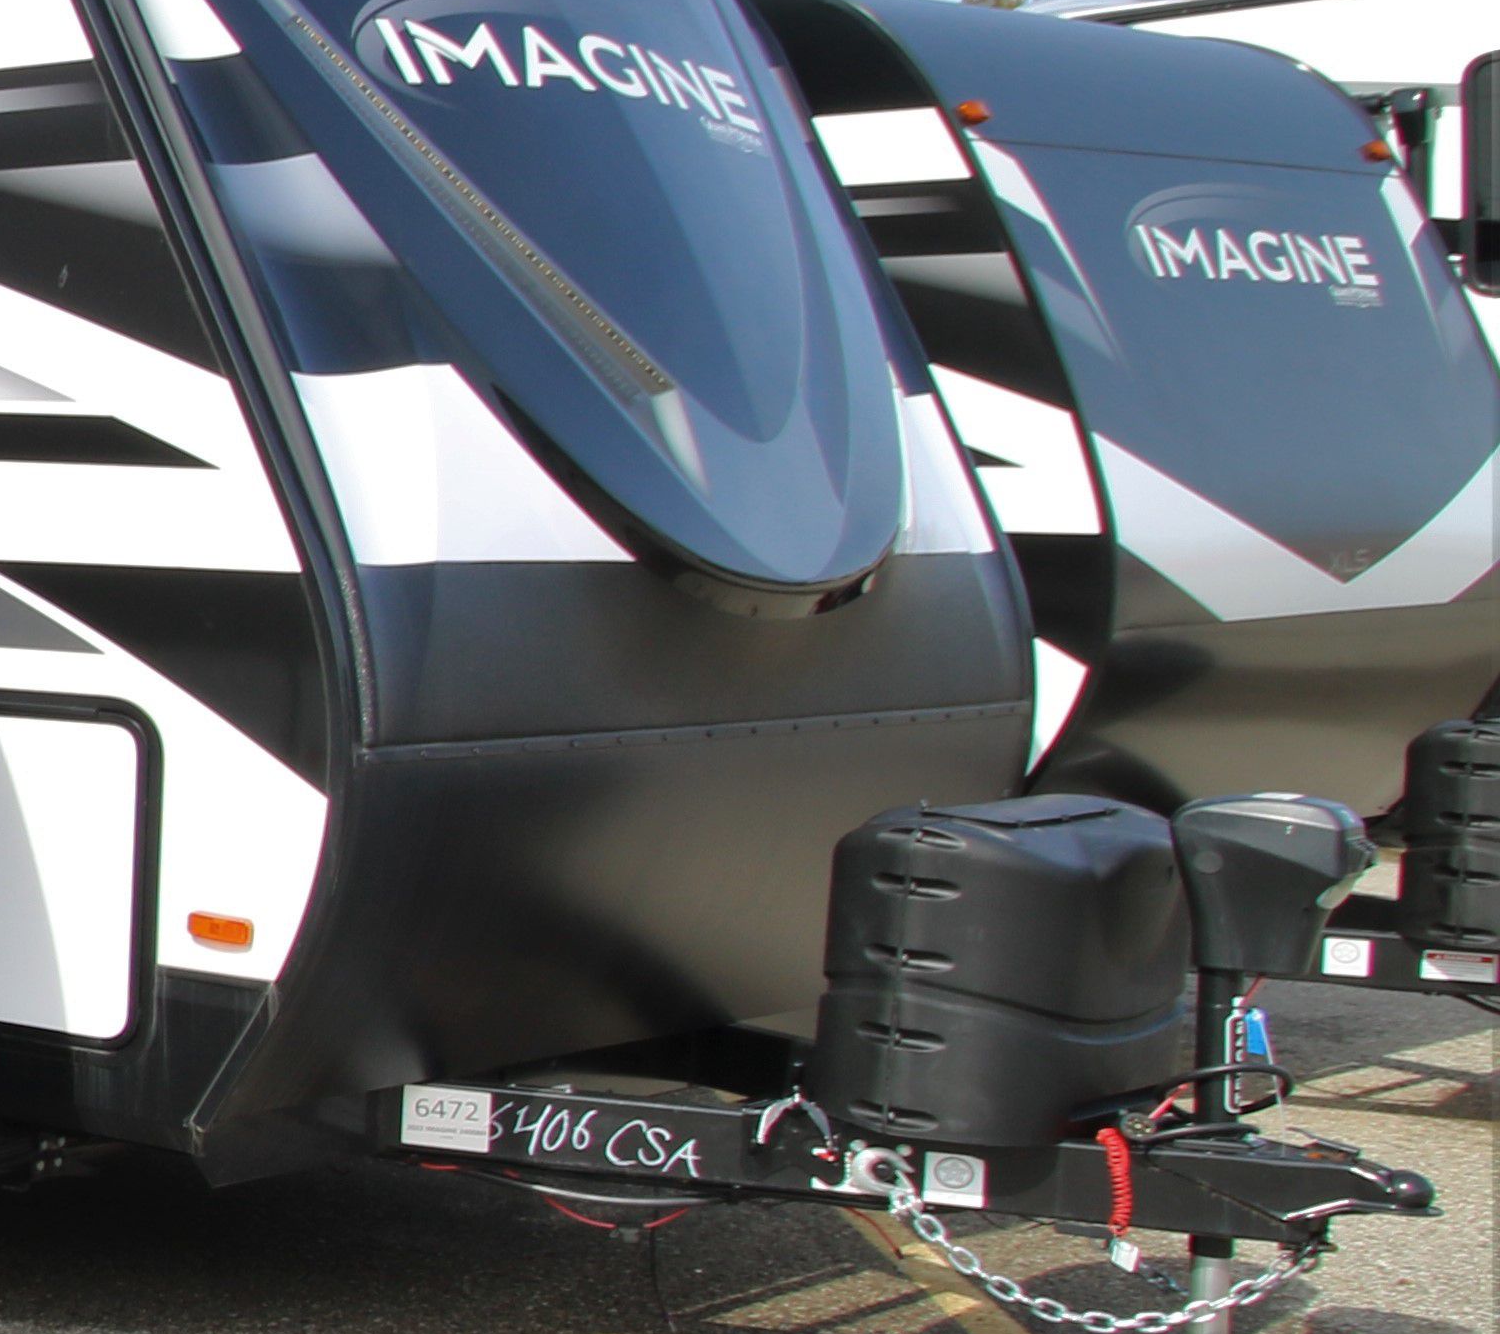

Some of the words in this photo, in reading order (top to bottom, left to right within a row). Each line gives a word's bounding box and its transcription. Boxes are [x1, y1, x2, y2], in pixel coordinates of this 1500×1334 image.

[373, 16, 761, 133] IMAGINE
[1134, 223, 1379, 286] IMAGINE
[415, 1098, 479, 1121] 6472
[604, 1119, 702, 1178] CSA
